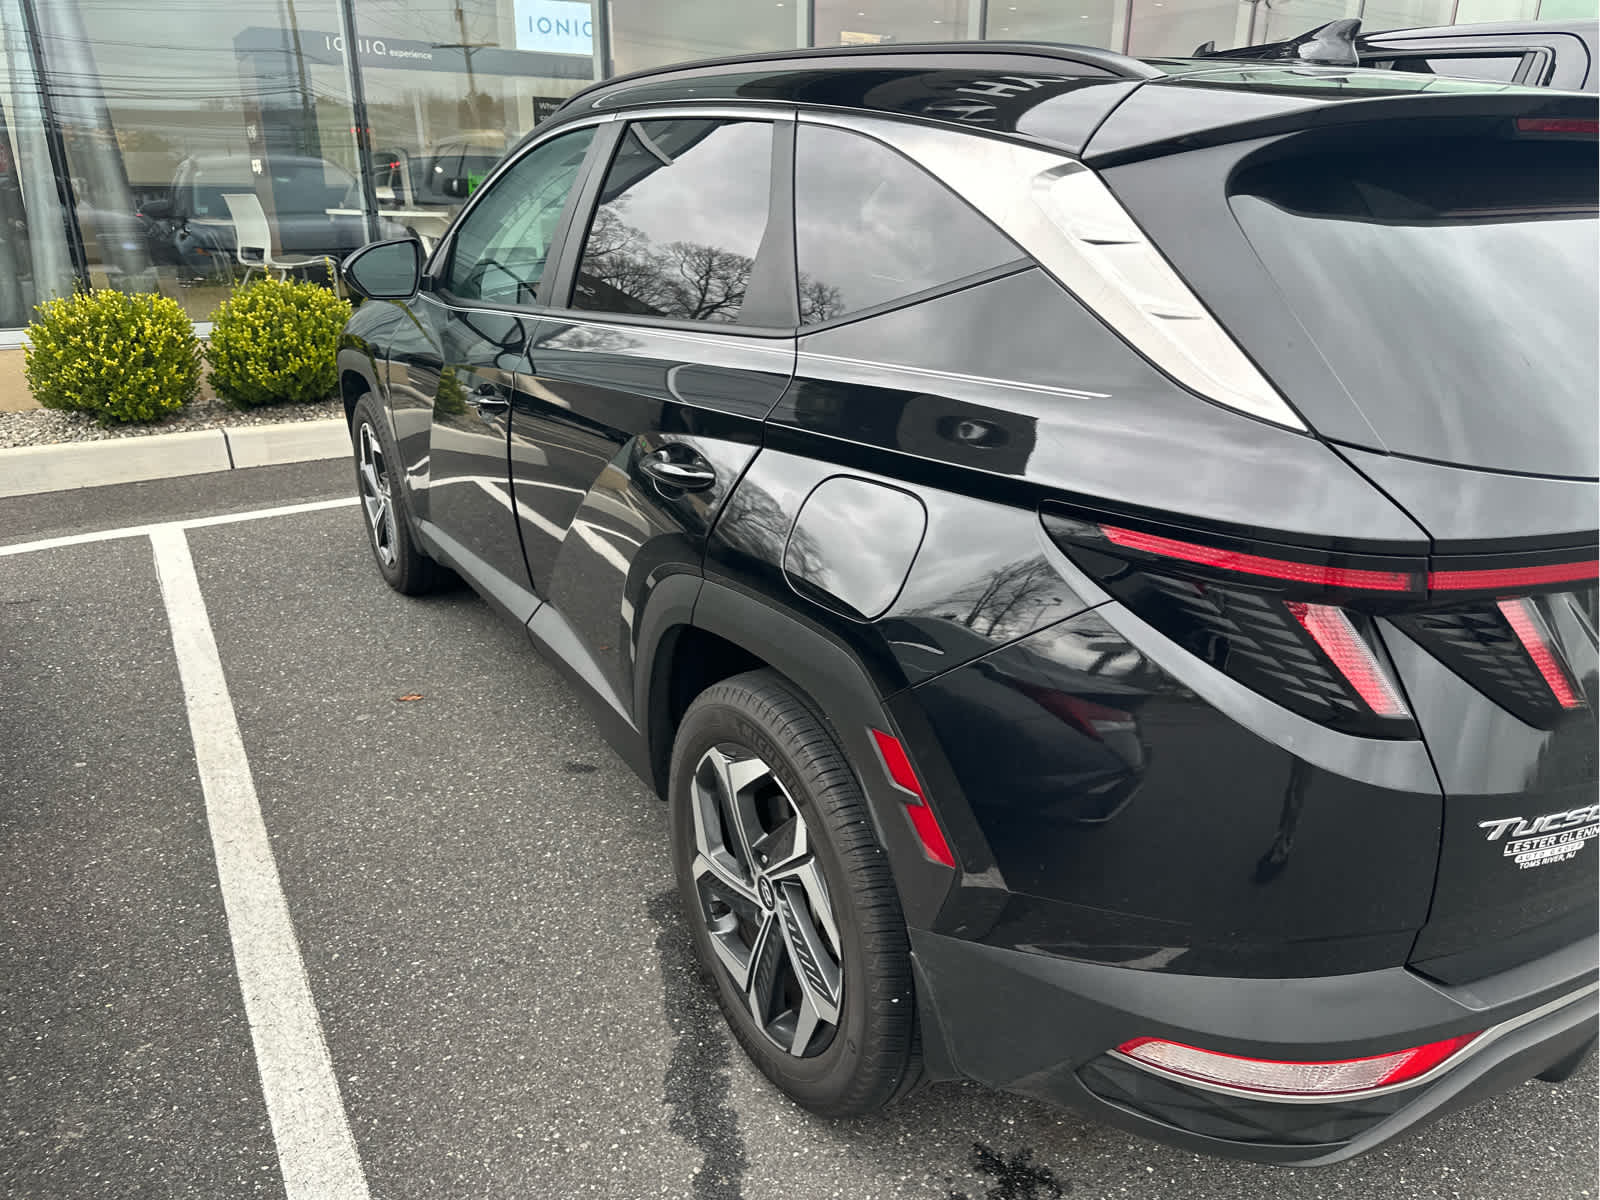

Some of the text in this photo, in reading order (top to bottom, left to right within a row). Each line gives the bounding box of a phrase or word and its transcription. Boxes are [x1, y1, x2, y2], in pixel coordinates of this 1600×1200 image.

[325, 35, 432, 61] IOIQ experience
[1504, 826, 1599, 855] LESTER GLENN
[1519, 858, 1541, 870] TOMS
[1565, 850, 1577, 860] NJ
